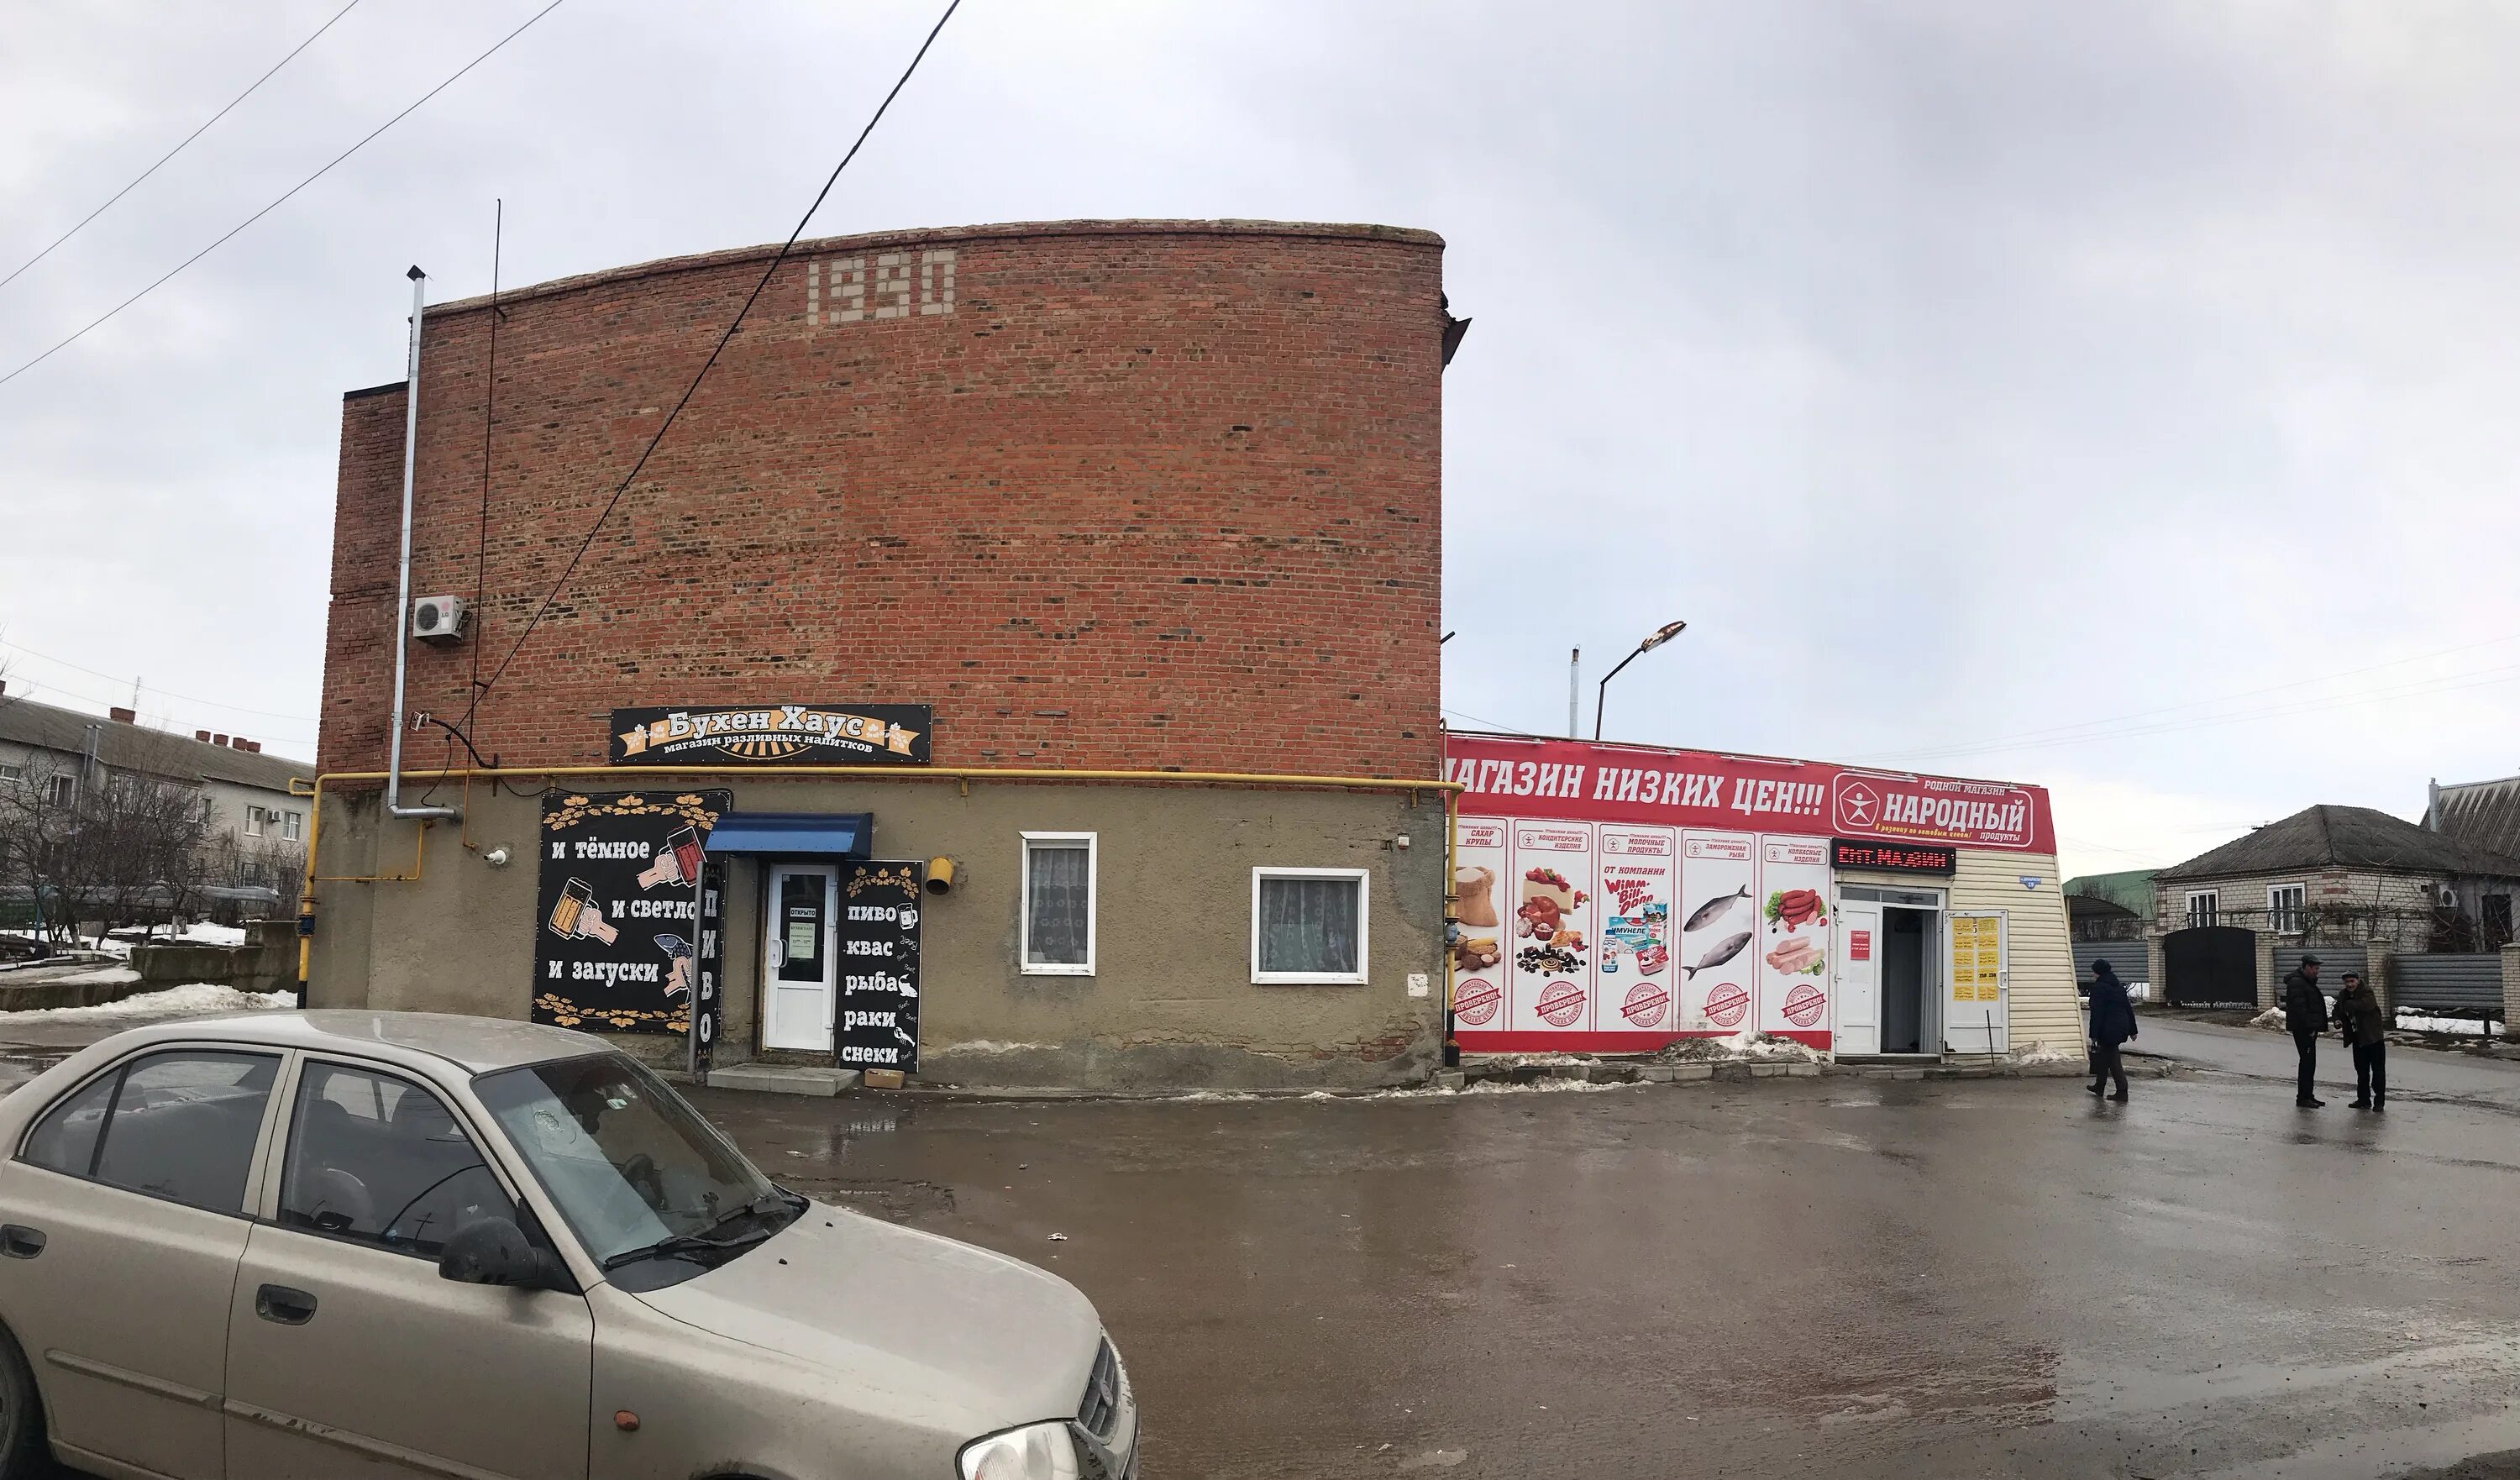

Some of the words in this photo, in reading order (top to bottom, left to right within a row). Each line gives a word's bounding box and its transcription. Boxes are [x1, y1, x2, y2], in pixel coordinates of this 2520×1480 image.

[807, 251, 955, 325] 1990
[668, 711, 770, 738] Бухен
[778, 706, 865, 738] Хаус
[664, 737, 722, 753] магазин
[723, 733, 801, 748] разливных
[804, 736, 873, 753] напитков
[1593, 767, 1725, 808] НИЗКИХ
[1730, 778, 1825, 816] ЦЕН!!!
[1963, 785, 2006, 796] МАГАЗИН
[1883, 793, 2025, 832] НАРОДНЫЙ
[1881, 826, 1908, 834] розницу
[1918, 828, 1947, 837] оптовым
[1980, 832, 2020, 842] продукты
[552, 842, 566, 859] и
[575, 837, 650, 859] тёмное
[1628, 838, 1665, 847] МОЛОЧНЫЕ
[1705, 843, 1746, 852] ЗАМОРОЖЕНАЯ
[612, 900, 625, 918] и
[631, 900, 696, 920] светло
[848, 905, 897, 922] пиво
[846, 940, 894, 957] квас
[549, 961, 563, 979] и
[572, 961, 659, 987] загуски
[700, 890, 718, 1042] ПИВО
[844, 971, 898, 995] рыба
[1455, 991, 1498, 1012] ПРОВЕРЕНО!
[1541, 994, 1583, 1014] ПРОВЕРЕНО!
[1625, 995, 1667, 1015] ПРОВЕРЕНО!
[1708, 995, 1746, 1014] ПРОВЕРЕНО!
[1787, 996, 1824, 1015] ПРОВЕРЕНО!
[843, 1010, 896, 1031] раки
[842, 1046, 898, 1063] снеки
